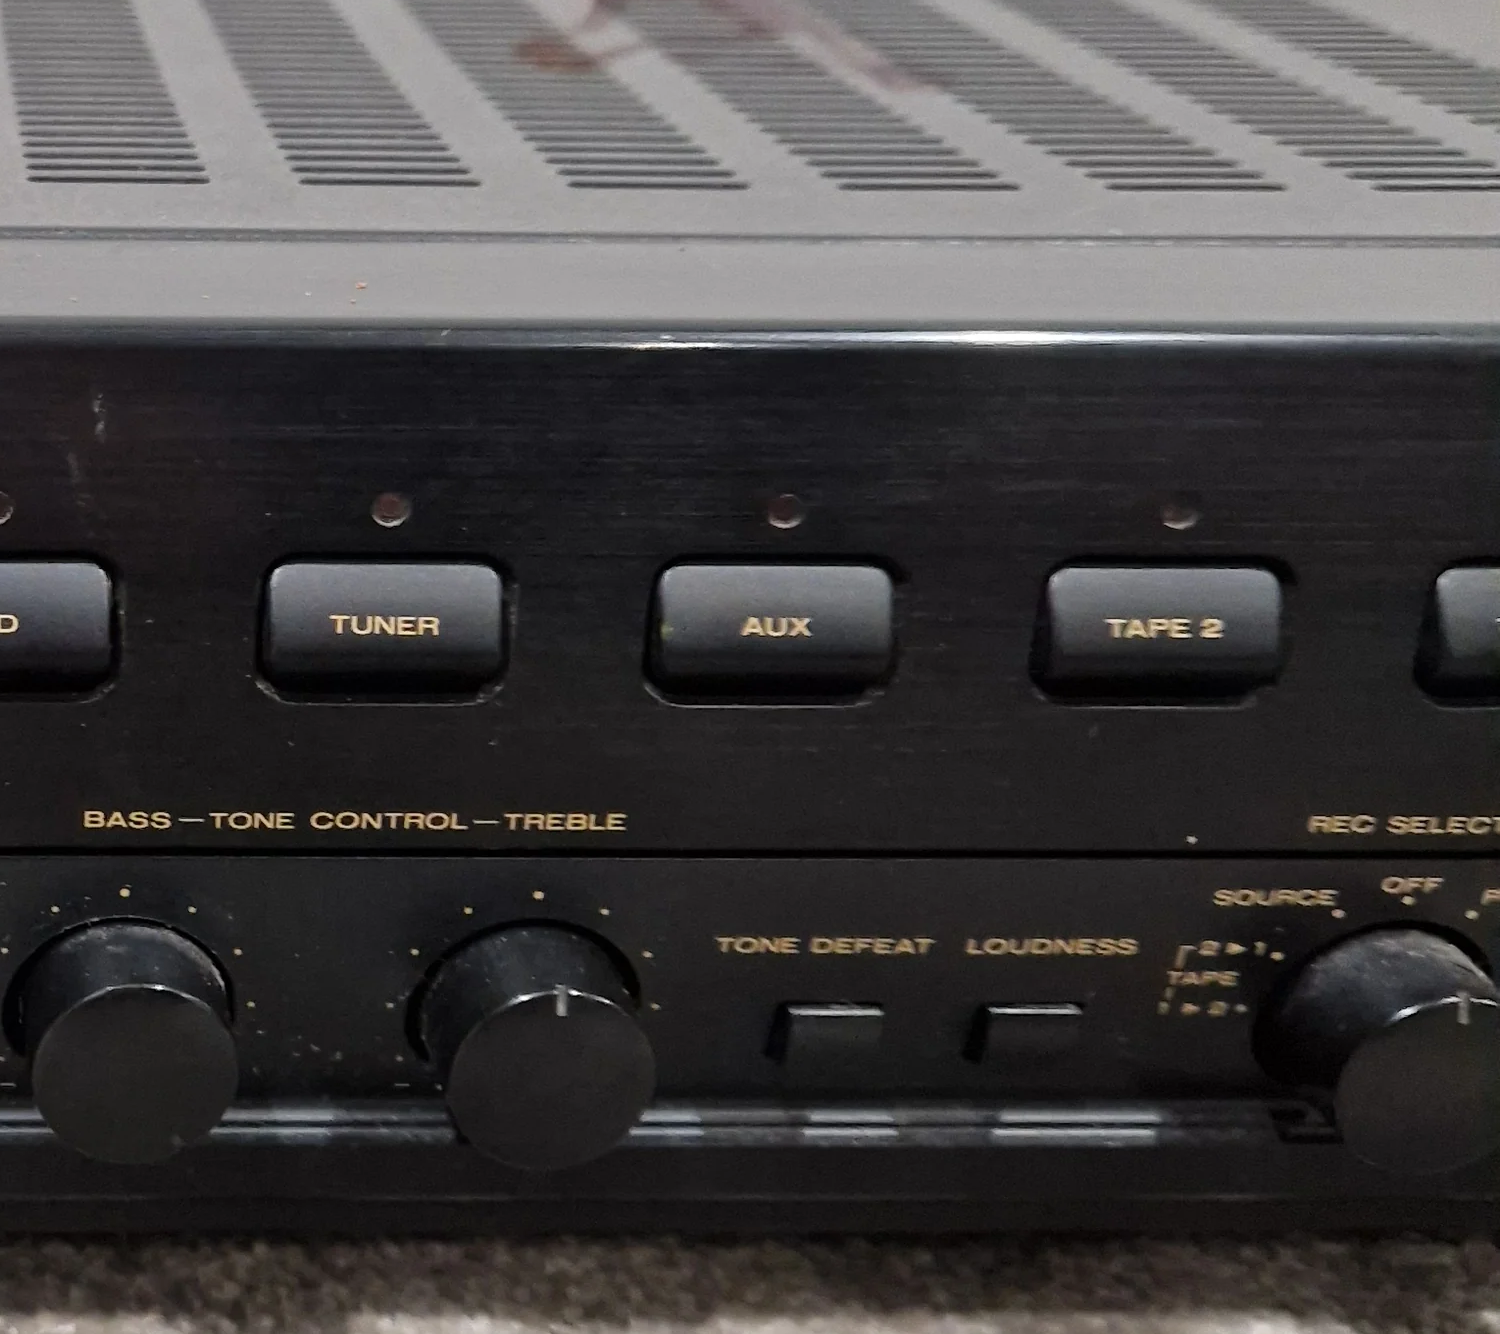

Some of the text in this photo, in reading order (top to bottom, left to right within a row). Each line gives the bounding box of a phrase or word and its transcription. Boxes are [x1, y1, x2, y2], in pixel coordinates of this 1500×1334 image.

[328, 614, 440, 636] TUNER
[740, 616, 813, 637] AUX
[1105, 618, 1224, 639] TAPE 2
[309, 811, 469, 831] CONTROL
[1307, 814, 1376, 834] REC
[1381, 875, 1443, 893] OFF
[1212, 889, 1337, 907] SOURCE
[715, 936, 934, 955] TONE DEFEAT
[967, 937, 1138, 956] LOUDNESS
